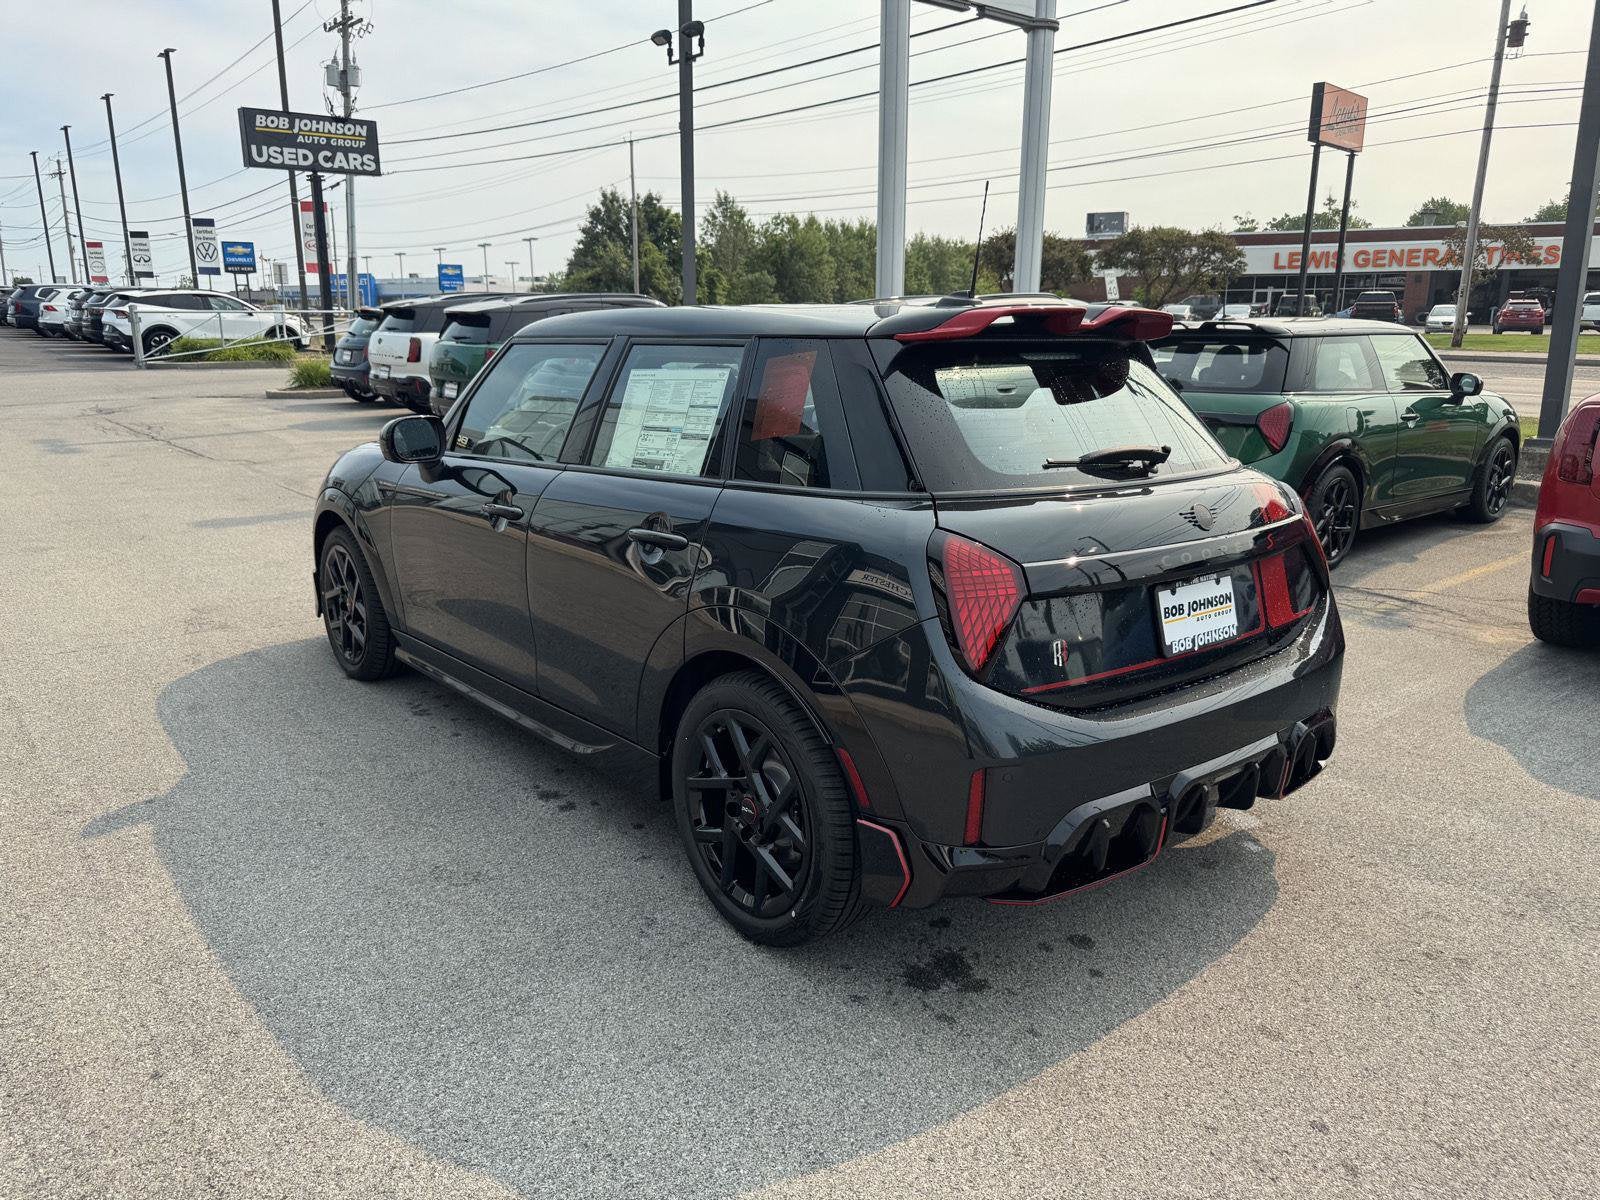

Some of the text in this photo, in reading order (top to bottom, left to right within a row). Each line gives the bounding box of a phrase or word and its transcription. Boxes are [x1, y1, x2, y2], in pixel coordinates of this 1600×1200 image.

[255, 114, 368, 137] BOB JOHNSON
[297, 135, 366, 148] AUTO GROUP
[250, 144, 377, 171] USED CARS
[1274, 250, 1345, 270] LEWIS
[1353, 247, 1462, 268] GENERA
[1108, 286, 1117, 295] 40
[1163, 592, 1232, 619] BOB JOHNSON
[1196, 608, 1232, 622] AUTO GROUP
[1172, 624, 1238, 654] BOB JOHNSON
